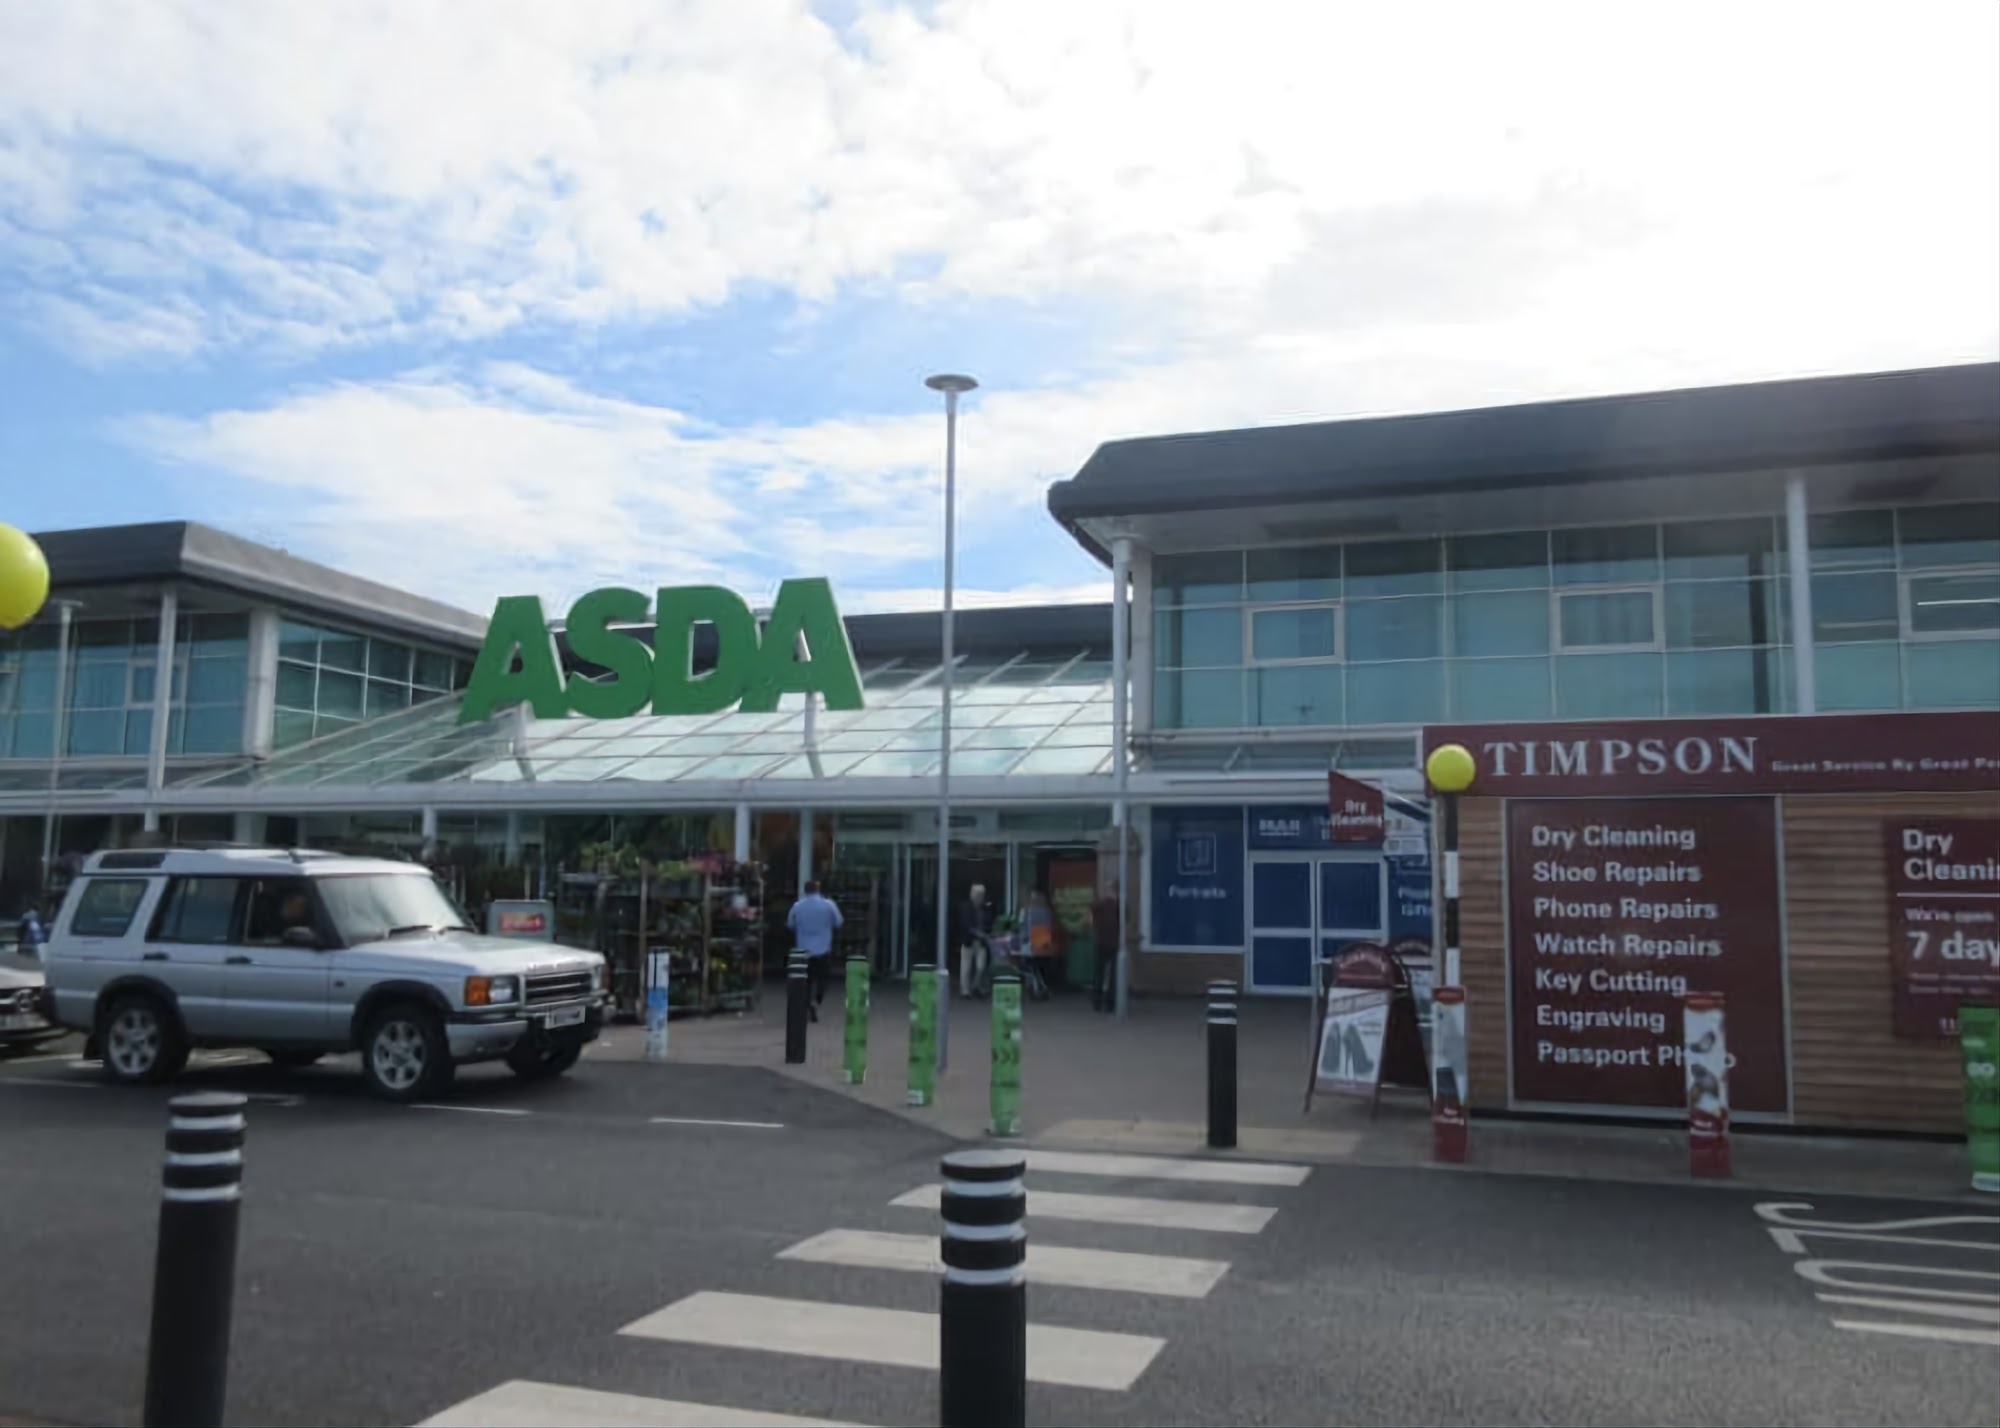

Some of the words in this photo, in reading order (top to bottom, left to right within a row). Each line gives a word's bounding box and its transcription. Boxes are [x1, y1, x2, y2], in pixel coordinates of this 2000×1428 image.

[457, 576, 865, 725] ASDA
[1484, 737, 1759, 776] TIMPSON
[1974, 757, 2000, 769] Pe
[1531, 825, 1576, 850] Dry
[1583, 824, 1695, 850] Cleaning
[1902, 828, 1953, 856] Dry
[1532, 861, 1597, 882] Shoe
[1604, 860, 1702, 886] Repairs
[1903, 857, 2000, 881] Cleani
[1534, 896, 1612, 919] Phone
[1619, 897, 1719, 922] Repairs
[1534, 932, 1616, 954] Watch
[1623, 933, 1722, 959] Repairs
[1906, 930, 1930, 960] 7
[1535, 966, 1582, 995] Key
[1589, 968, 1687, 997] Cutting
[1536, 1004, 1665, 1033] Engraving
[1537, 1039, 1649, 1067] Passport
